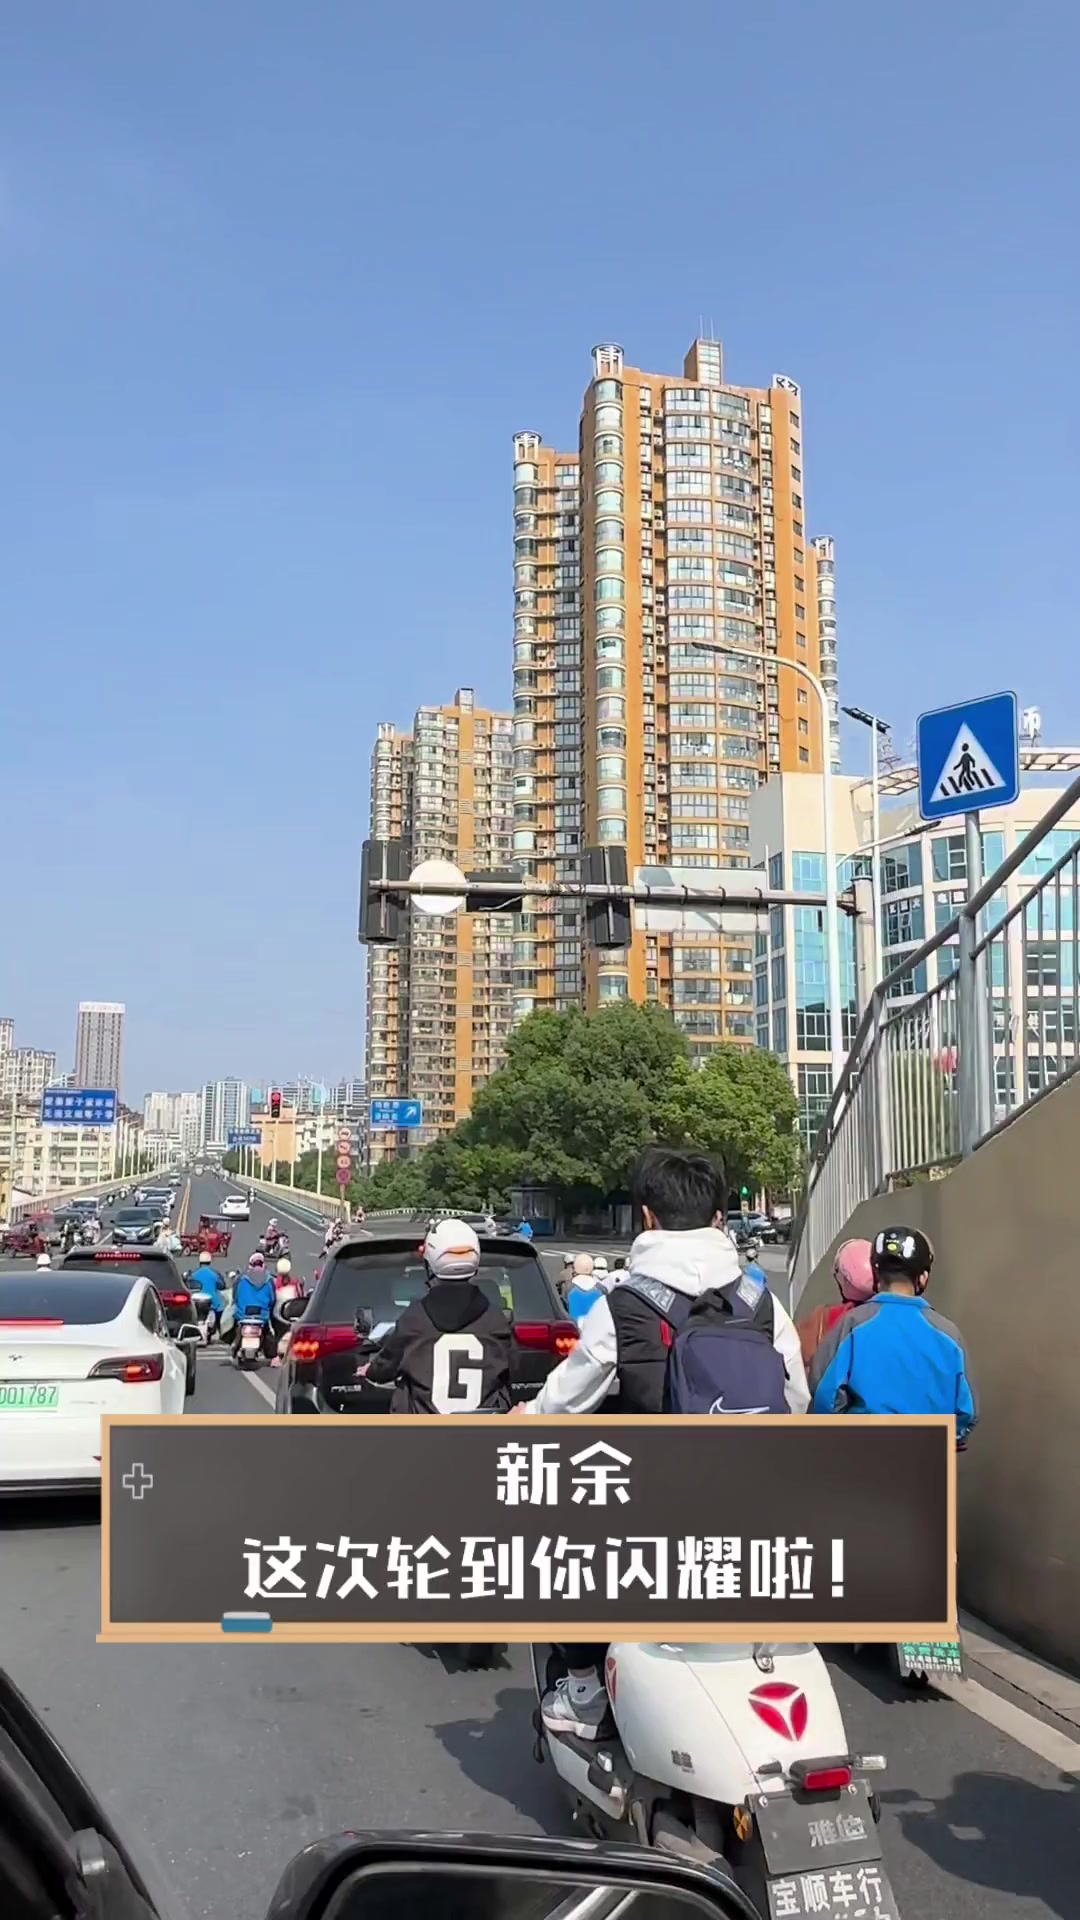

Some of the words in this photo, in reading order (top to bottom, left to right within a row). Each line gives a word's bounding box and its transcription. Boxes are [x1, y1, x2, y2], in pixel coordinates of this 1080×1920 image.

[432, 1334, 484, 1415] G
[771, 1867, 882, 1917] 宝顺车行
